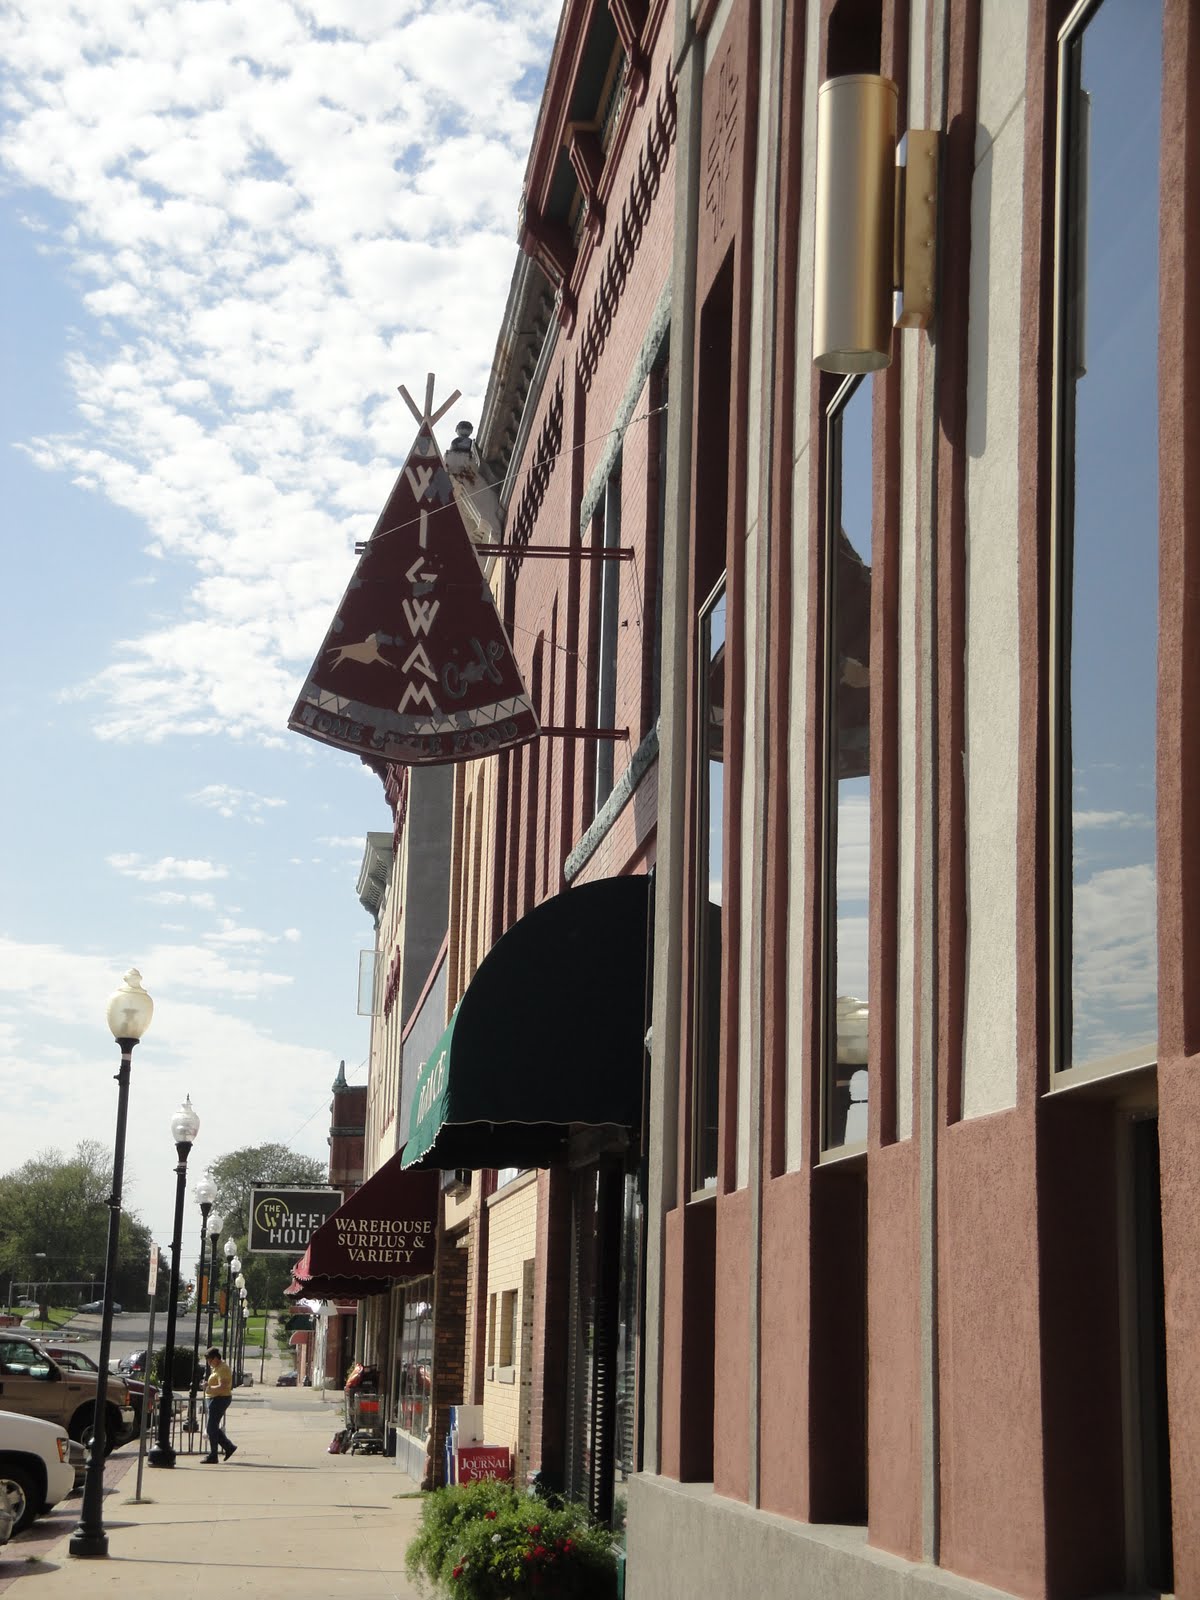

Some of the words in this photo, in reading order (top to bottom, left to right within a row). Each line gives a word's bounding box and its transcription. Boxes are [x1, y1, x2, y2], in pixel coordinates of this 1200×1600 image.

[397, 465, 440, 715] WIGWAM
[442, 637, 505, 699] Cfe
[301, 706, 365, 742] HOME
[370, 728, 443, 752] STLE
[455, 721, 518, 752] FOOD
[264, 1204, 281, 1213] THE
[335, 1218, 432, 1234] WAREHOUSE
[337, 1233, 406, 1248] SURPLUS
[413, 1235, 426, 1248] &
[348, 1248, 414, 1263] VARIETY
[461, 1457, 508, 1470] JOURNAL
[470, 1468, 497, 1479] STAR
